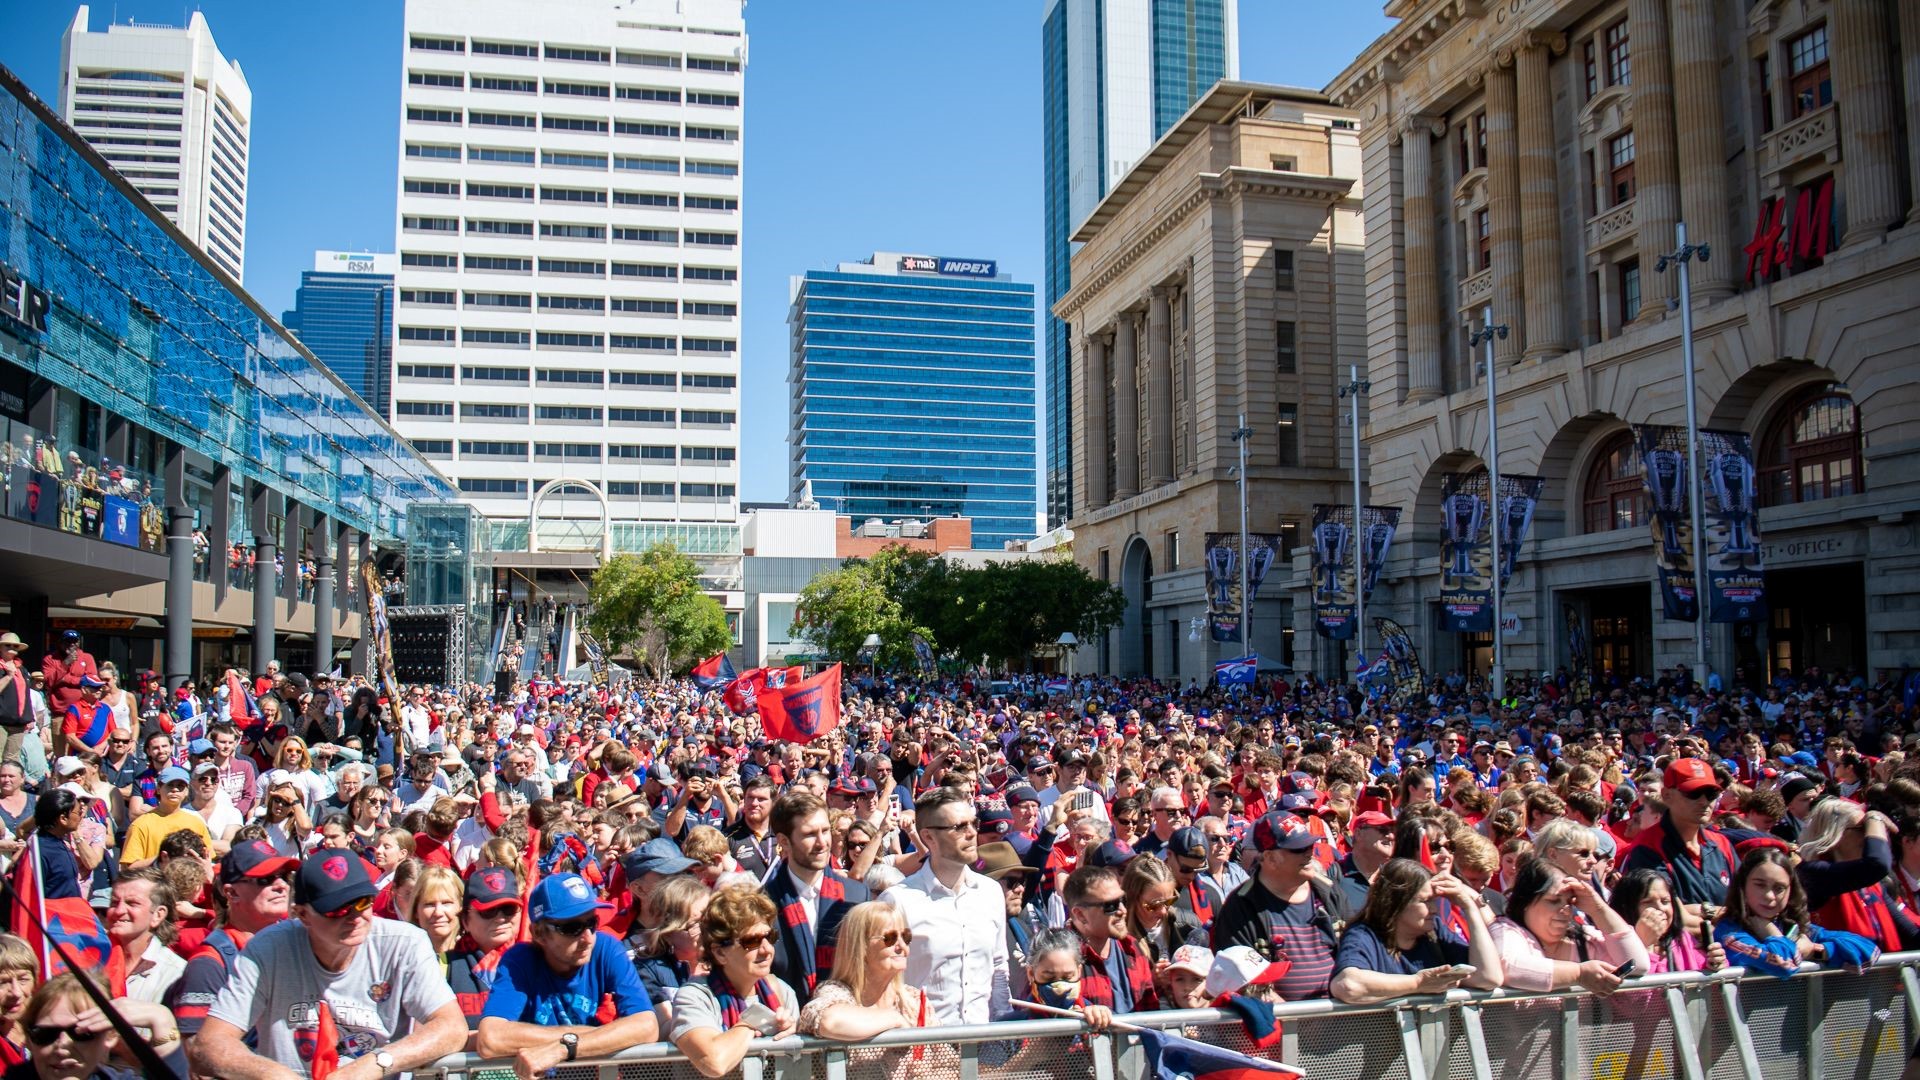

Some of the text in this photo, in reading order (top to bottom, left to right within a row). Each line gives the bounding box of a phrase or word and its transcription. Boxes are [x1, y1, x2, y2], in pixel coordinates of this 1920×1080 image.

[1743, 177, 1834, 282] H&M
[348, 261, 375, 272] RSM
[916, 258, 936, 270] nab
[944, 261, 991, 274] INPEX
[1787, 539, 1836, 556] OFFICE
[1442, 595, 1486, 604] FINALS
[336, 1005, 384, 1030] FINAL
